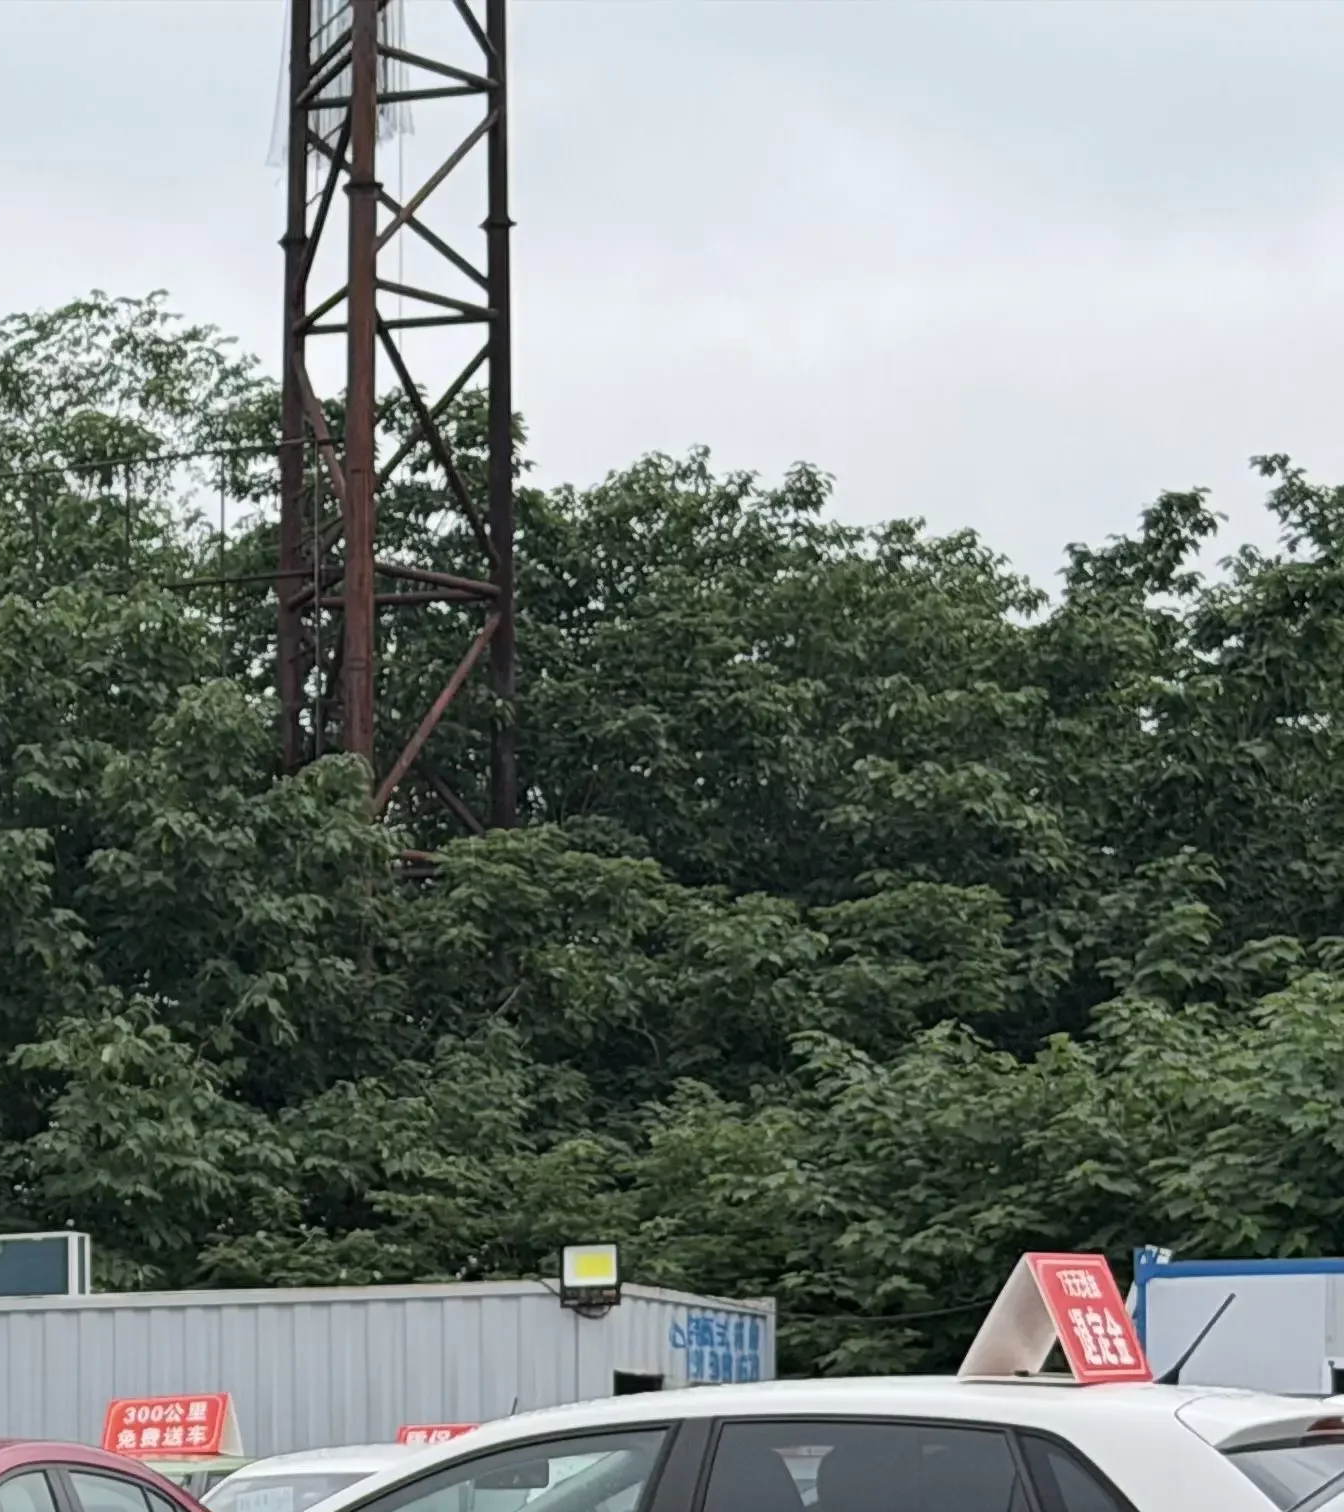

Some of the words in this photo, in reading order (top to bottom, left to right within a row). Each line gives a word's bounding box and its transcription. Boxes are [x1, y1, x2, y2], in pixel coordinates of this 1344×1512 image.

[123, 1401, 208, 1425] 300公里
[116, 1424, 208, 1449] 免费送车
